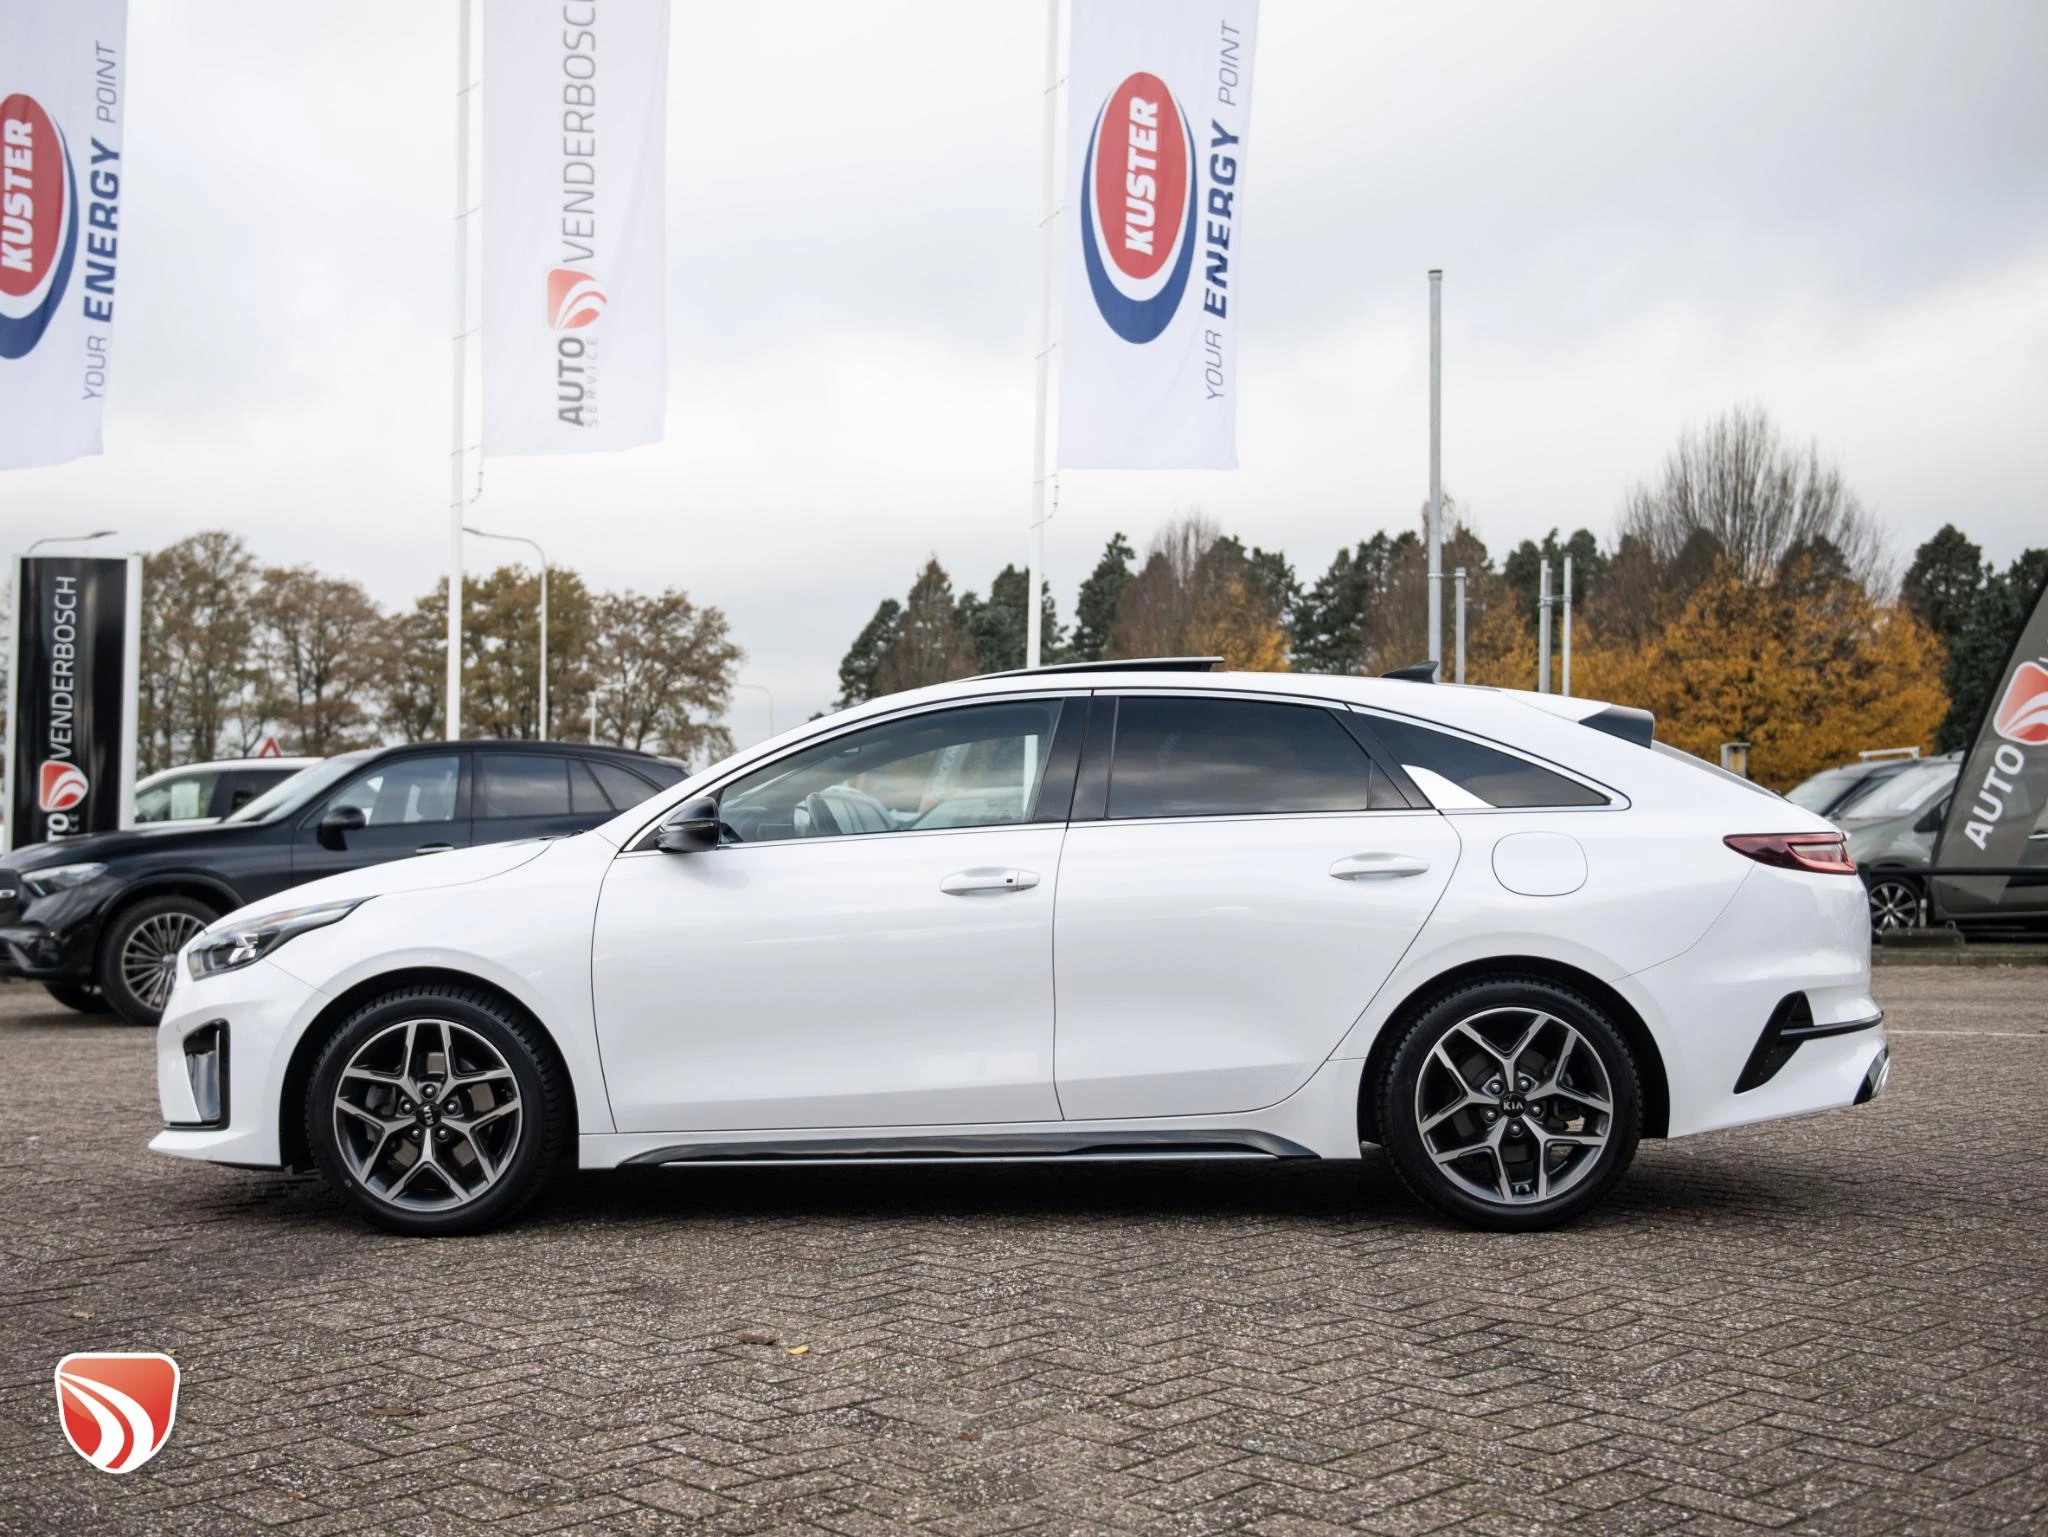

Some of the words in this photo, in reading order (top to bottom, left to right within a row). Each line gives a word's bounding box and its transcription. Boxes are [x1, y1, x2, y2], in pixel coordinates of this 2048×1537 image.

[95, 40, 118, 124] POINT
[1219, 19, 1241, 107] POINT
[563, 0, 596, 263] VENDERBOSC
[1125, 97, 1158, 256] KUSTER
[1, 118, 33, 272] KUSTER
[83, 137, 120, 323] ENERGY
[1204, 119, 1239, 319] ENERGY
[82, 335, 108, 400] YOUR
[558, 336, 585, 427] AUTO
[586, 337, 598, 427] SERVICE
[1206, 330, 1223, 401] YOUR
[50, 576, 77, 759] VENDERBOSCH
[48, 813, 69, 842] TO
[1964, 744, 2024, 850] AUTO
[1503, 1101, 1523, 1110] KIA
